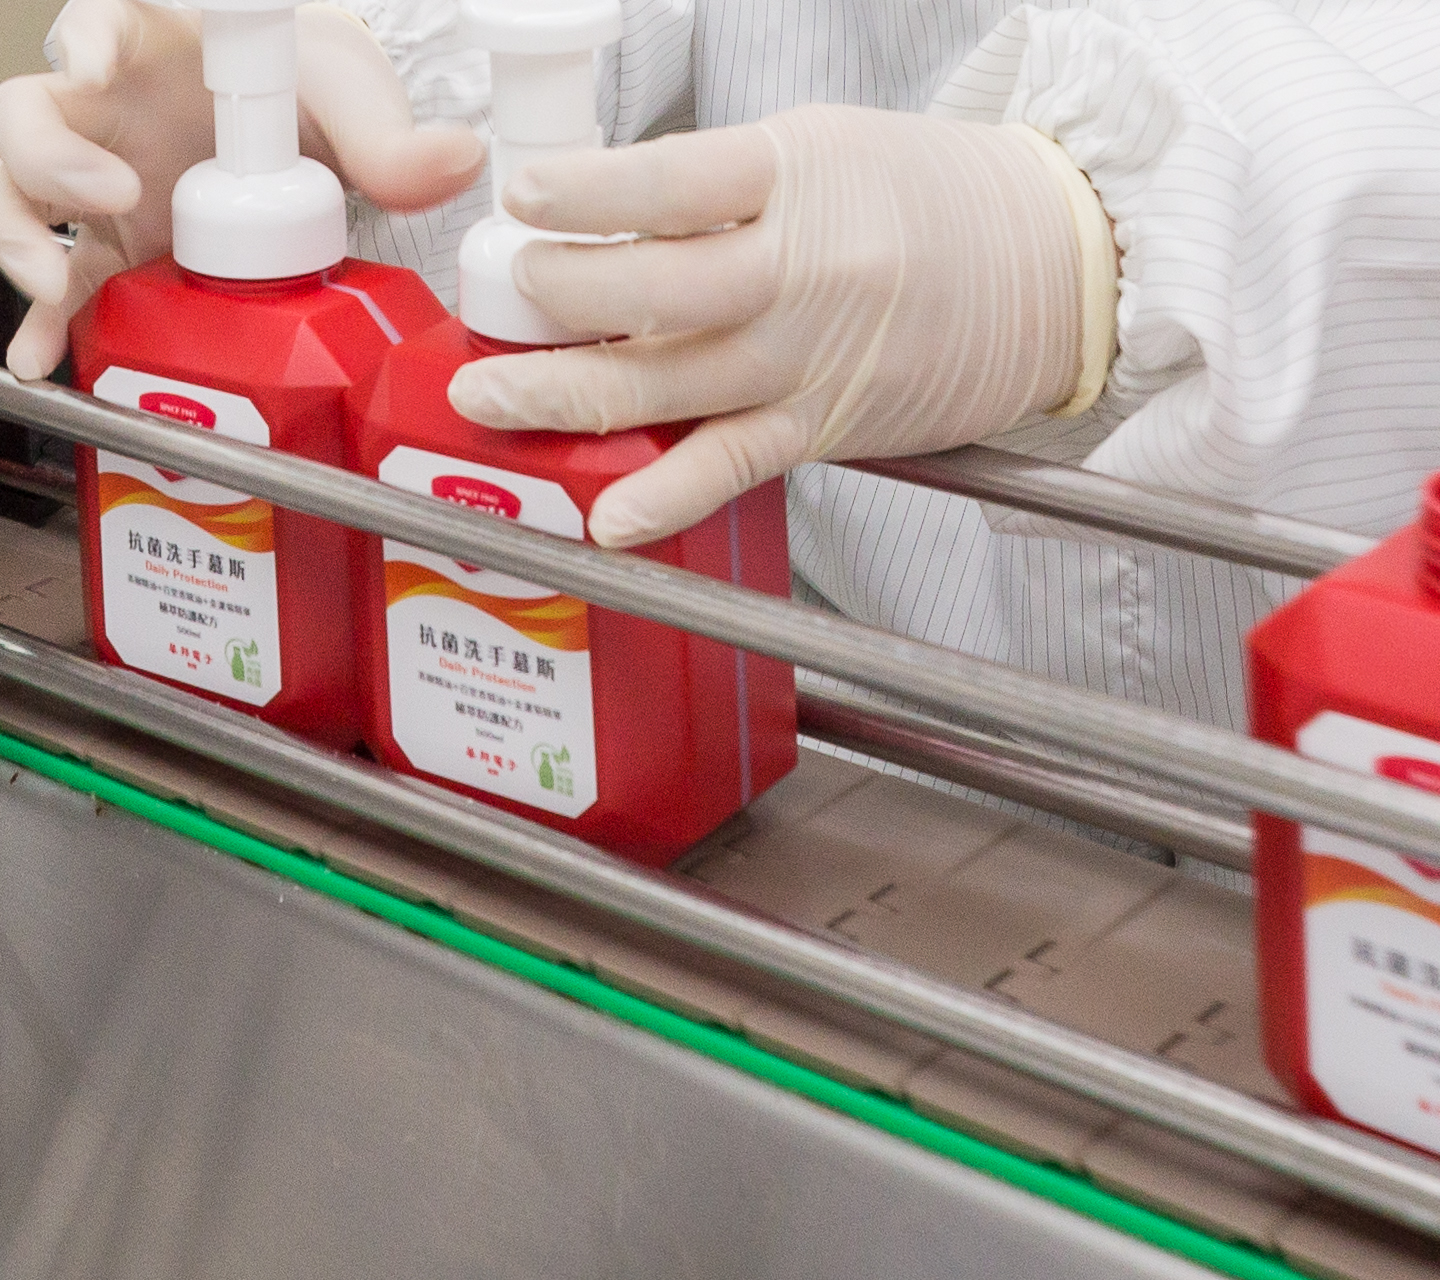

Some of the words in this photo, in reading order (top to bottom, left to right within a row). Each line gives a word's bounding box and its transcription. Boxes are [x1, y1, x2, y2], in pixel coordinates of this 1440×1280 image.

[128, 529, 246, 581] 抗菌洗手慕斯
[145, 560, 169, 577] Daily
[173, 569, 228, 592] Protection
[420, 623, 556, 682] 抗菌洗手慕斯
[438, 656, 467, 674] Daily
[471, 666, 537, 694] Protection
